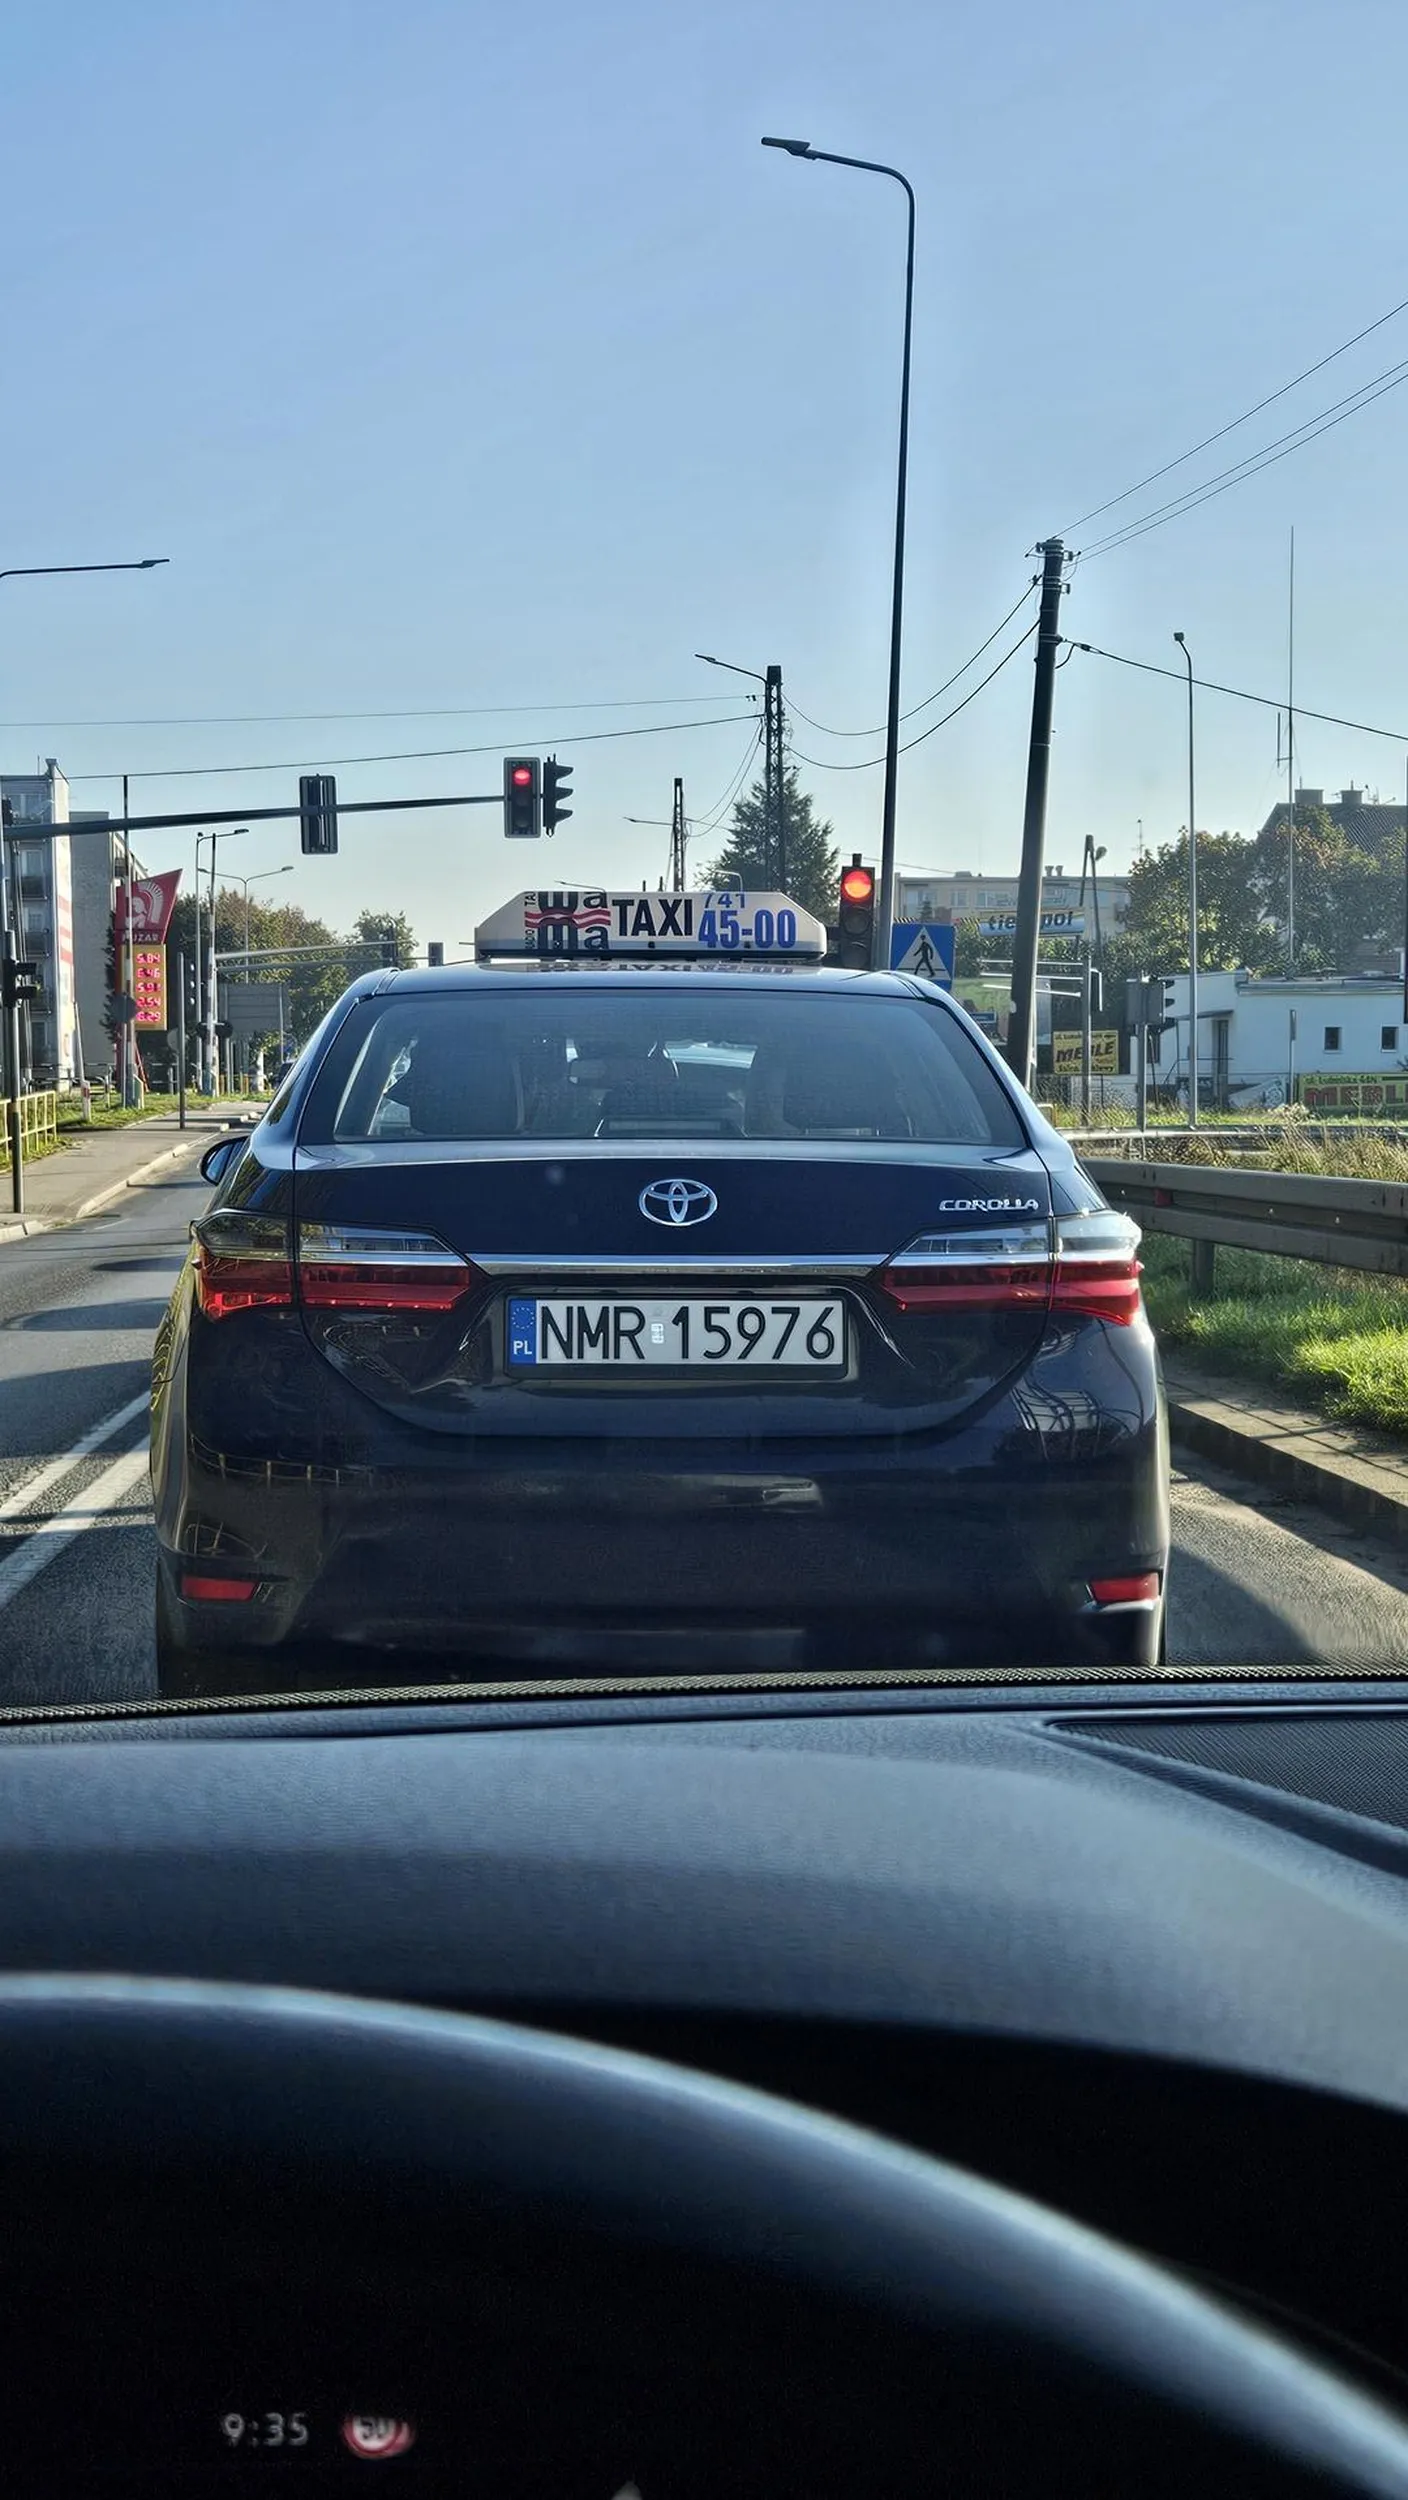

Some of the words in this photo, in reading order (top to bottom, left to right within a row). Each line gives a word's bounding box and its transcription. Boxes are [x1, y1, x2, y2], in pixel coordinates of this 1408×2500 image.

[612, 899, 693, 936] TAXI
[698, 909, 797, 949] 45-00
[1056, 1041, 1114, 1062] MELE
[939, 1199, 1039, 1212] COROLLA
[513, 1340, 532, 1355] PL
[541, 1306, 646, 1359] NMR
[672, 1306, 835, 1359] 15976
[222, 2413, 308, 2447] 9:35
